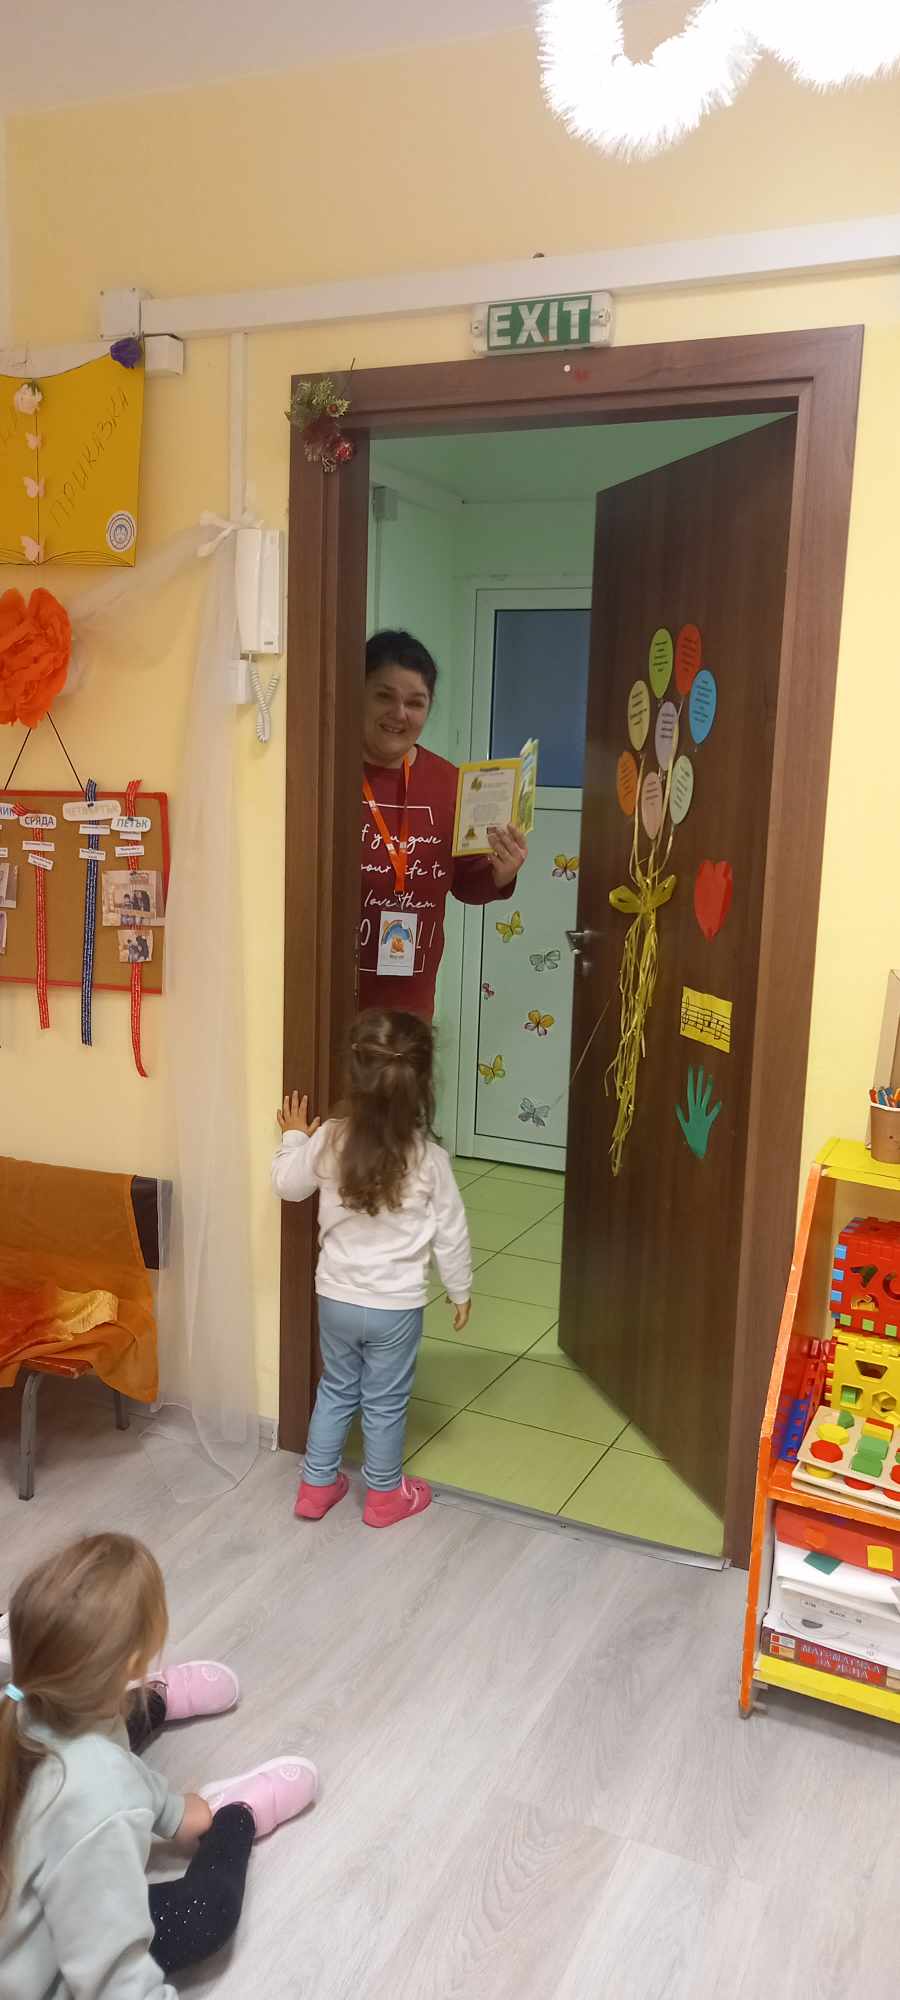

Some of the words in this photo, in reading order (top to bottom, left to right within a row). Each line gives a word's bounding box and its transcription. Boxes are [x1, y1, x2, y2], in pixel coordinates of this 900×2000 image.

[488, 298, 590, 348] EXIT
[24, 815, 54, 828] СРЯДА
[116, 818, 148, 830] ПЕТЪК
[371, 832, 400, 850] yu
[406, 834, 442, 854] gave
[432, 860, 446, 879] to
[364, 889, 397, 908] love
[400, 889, 436, 911] them
